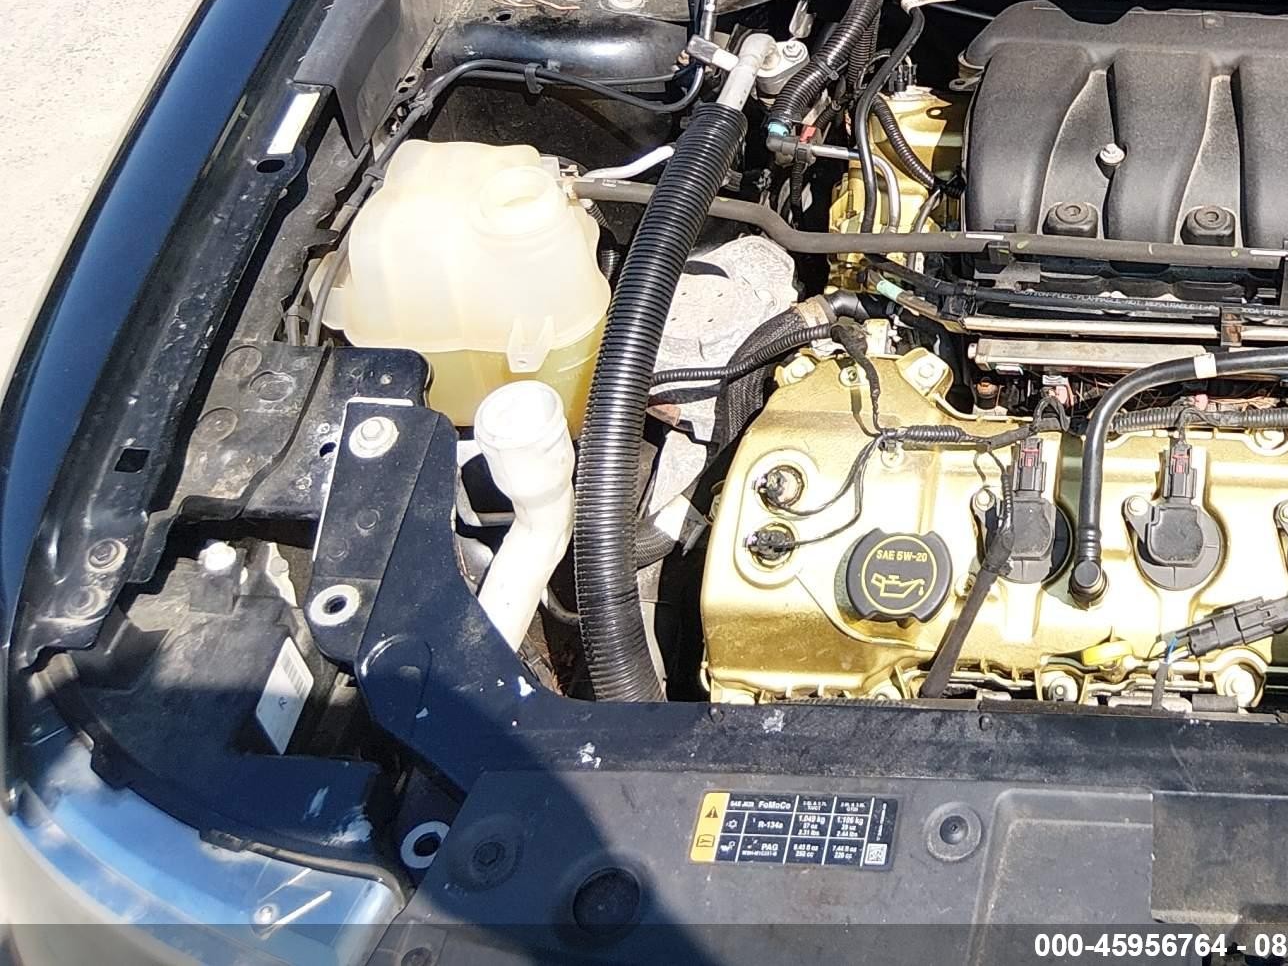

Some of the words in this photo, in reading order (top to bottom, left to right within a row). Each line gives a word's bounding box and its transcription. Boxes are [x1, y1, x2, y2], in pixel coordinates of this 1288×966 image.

[876, 549, 895, 560] SAE
[896, 551, 928, 563] 5W-20
[758, 801, 791, 810] FoMoCo
[817, 816, 825, 824] kg
[855, 817, 864, 826] kg
[758, 821, 784, 829] R-134a
[761, 843, 778, 851] PAG
